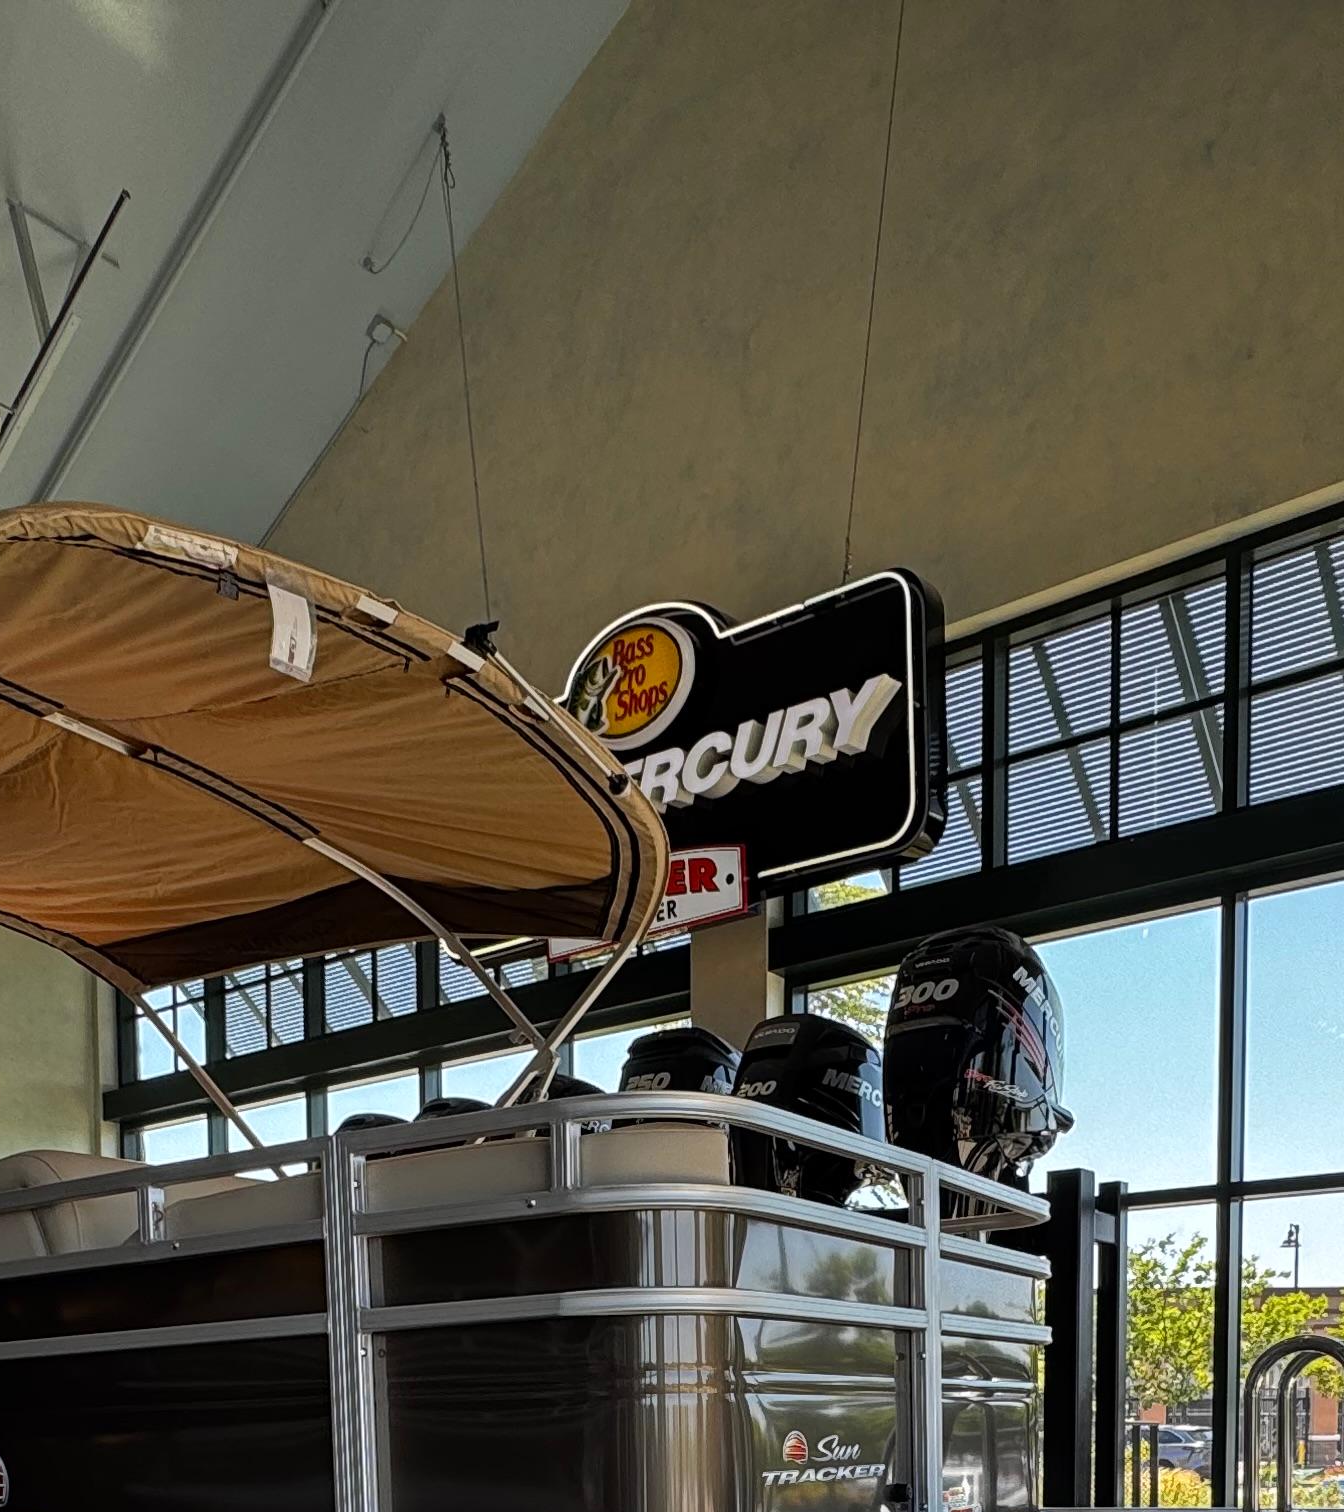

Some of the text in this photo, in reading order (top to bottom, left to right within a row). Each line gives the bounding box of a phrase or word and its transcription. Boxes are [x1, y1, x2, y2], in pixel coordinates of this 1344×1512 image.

[612, 633, 654, 667] Bass
[614, 663, 646, 694] Pro
[615, 681, 668, 722] Shops
[893, 978, 960, 1010] 300
[625, 1071, 672, 1092] 250
[810, 1433, 862, 1463] Sun
[761, 1463, 887, 1488] TRACKER
